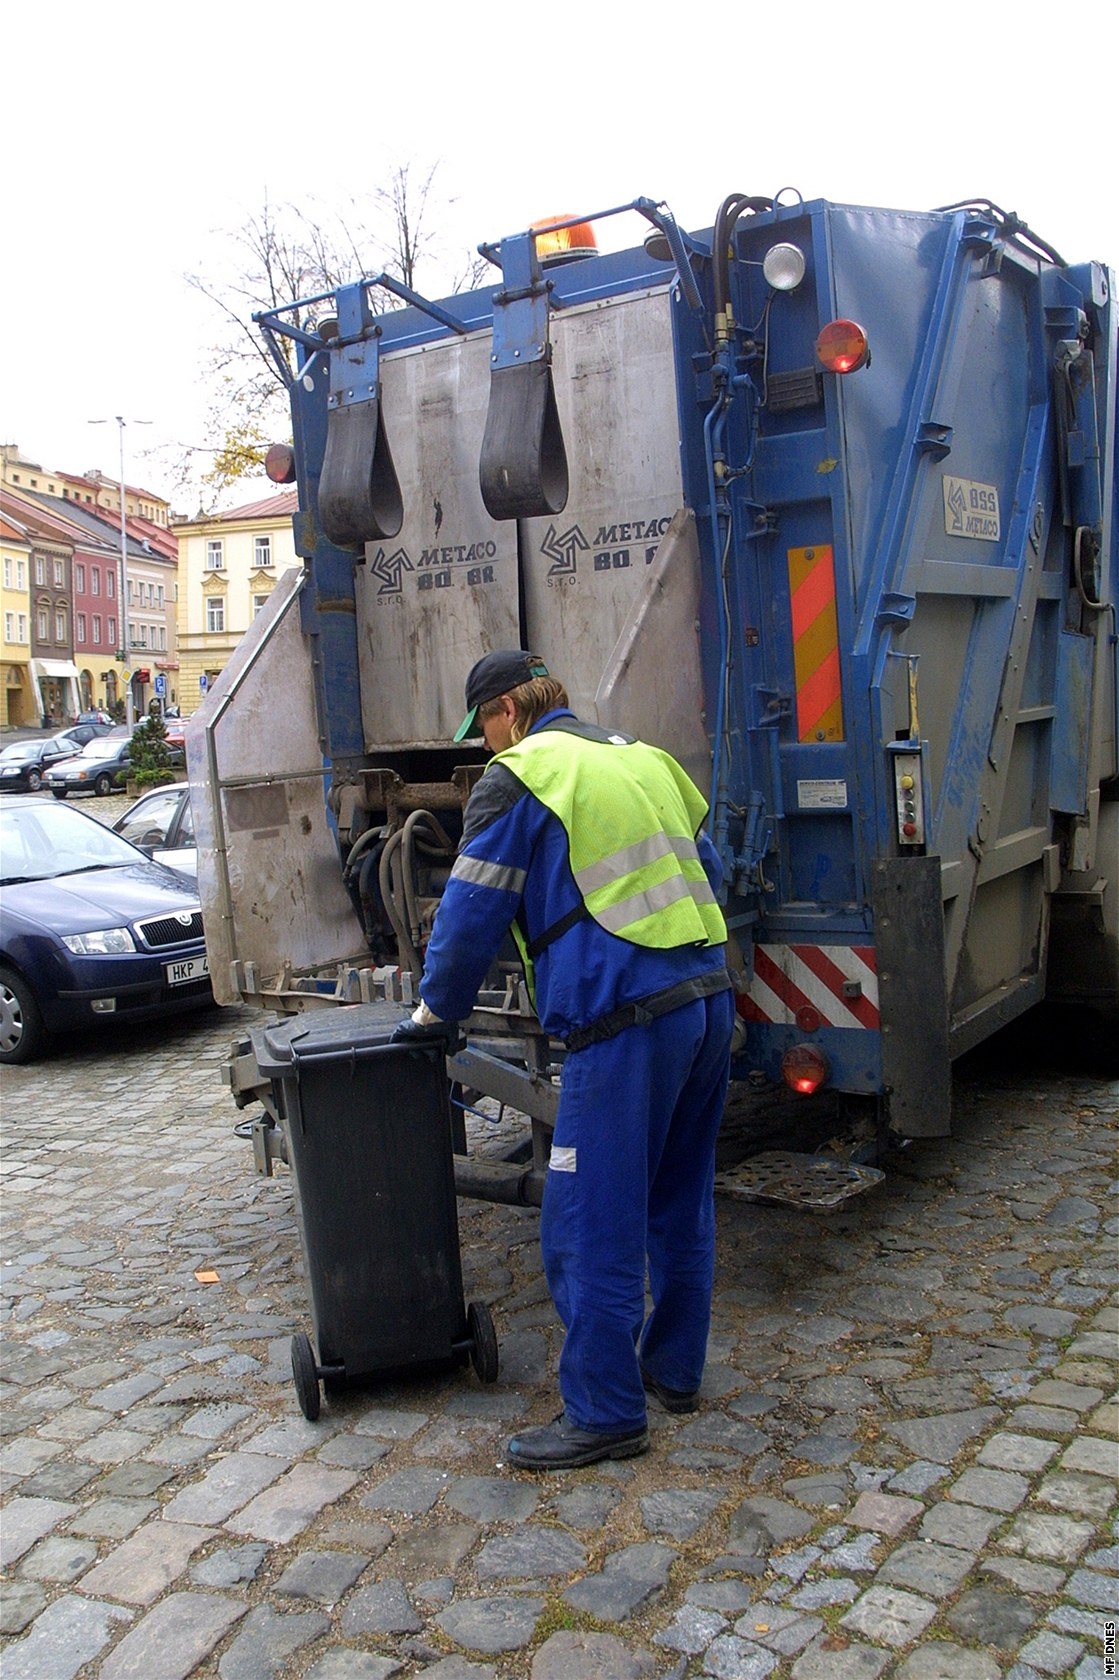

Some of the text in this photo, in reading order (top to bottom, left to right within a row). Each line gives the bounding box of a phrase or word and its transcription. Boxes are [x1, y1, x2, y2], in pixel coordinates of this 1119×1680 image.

[969, 488, 996, 512] BSS
[592, 516, 672, 546] METAC
[965, 515, 998, 537] METACO
[416, 540, 497, 567] METACO
[173, 962, 194, 980] HKP
